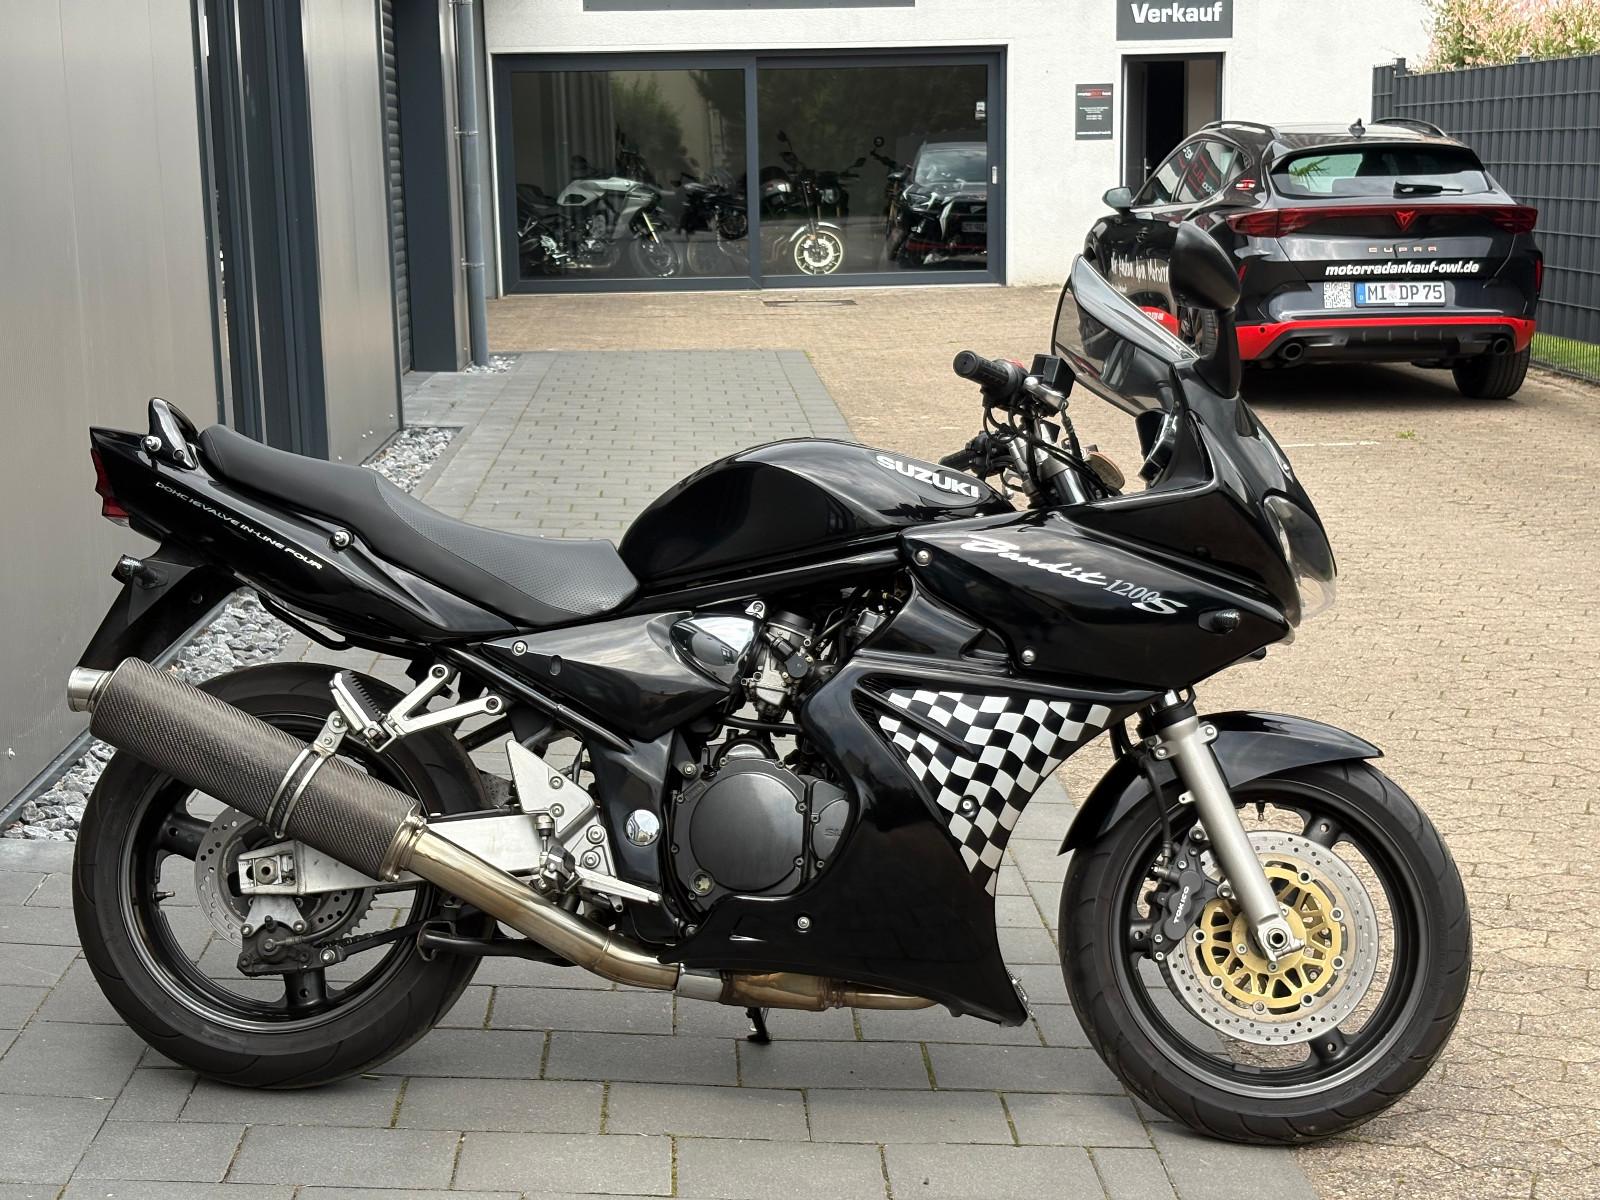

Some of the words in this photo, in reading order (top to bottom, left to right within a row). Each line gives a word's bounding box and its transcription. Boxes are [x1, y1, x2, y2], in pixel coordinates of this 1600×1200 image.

[1130, 1, 1223, 23] Verkauf
[1325, 260, 1480, 276] motorradankauf-owl.de
[1367, 284, 1387, 301] MI
[1400, 284, 1419, 301] DP
[1422, 284, 1443, 300] 75
[876, 455, 979, 498] SUZUKI
[155, 481, 189, 501] DOHC
[240, 524, 285, 550] IN-LINE
[284, 547, 323, 570] FOUR
[960, 534, 1107, 585] Bandit
[1173, 885, 1190, 924] TOKICO
